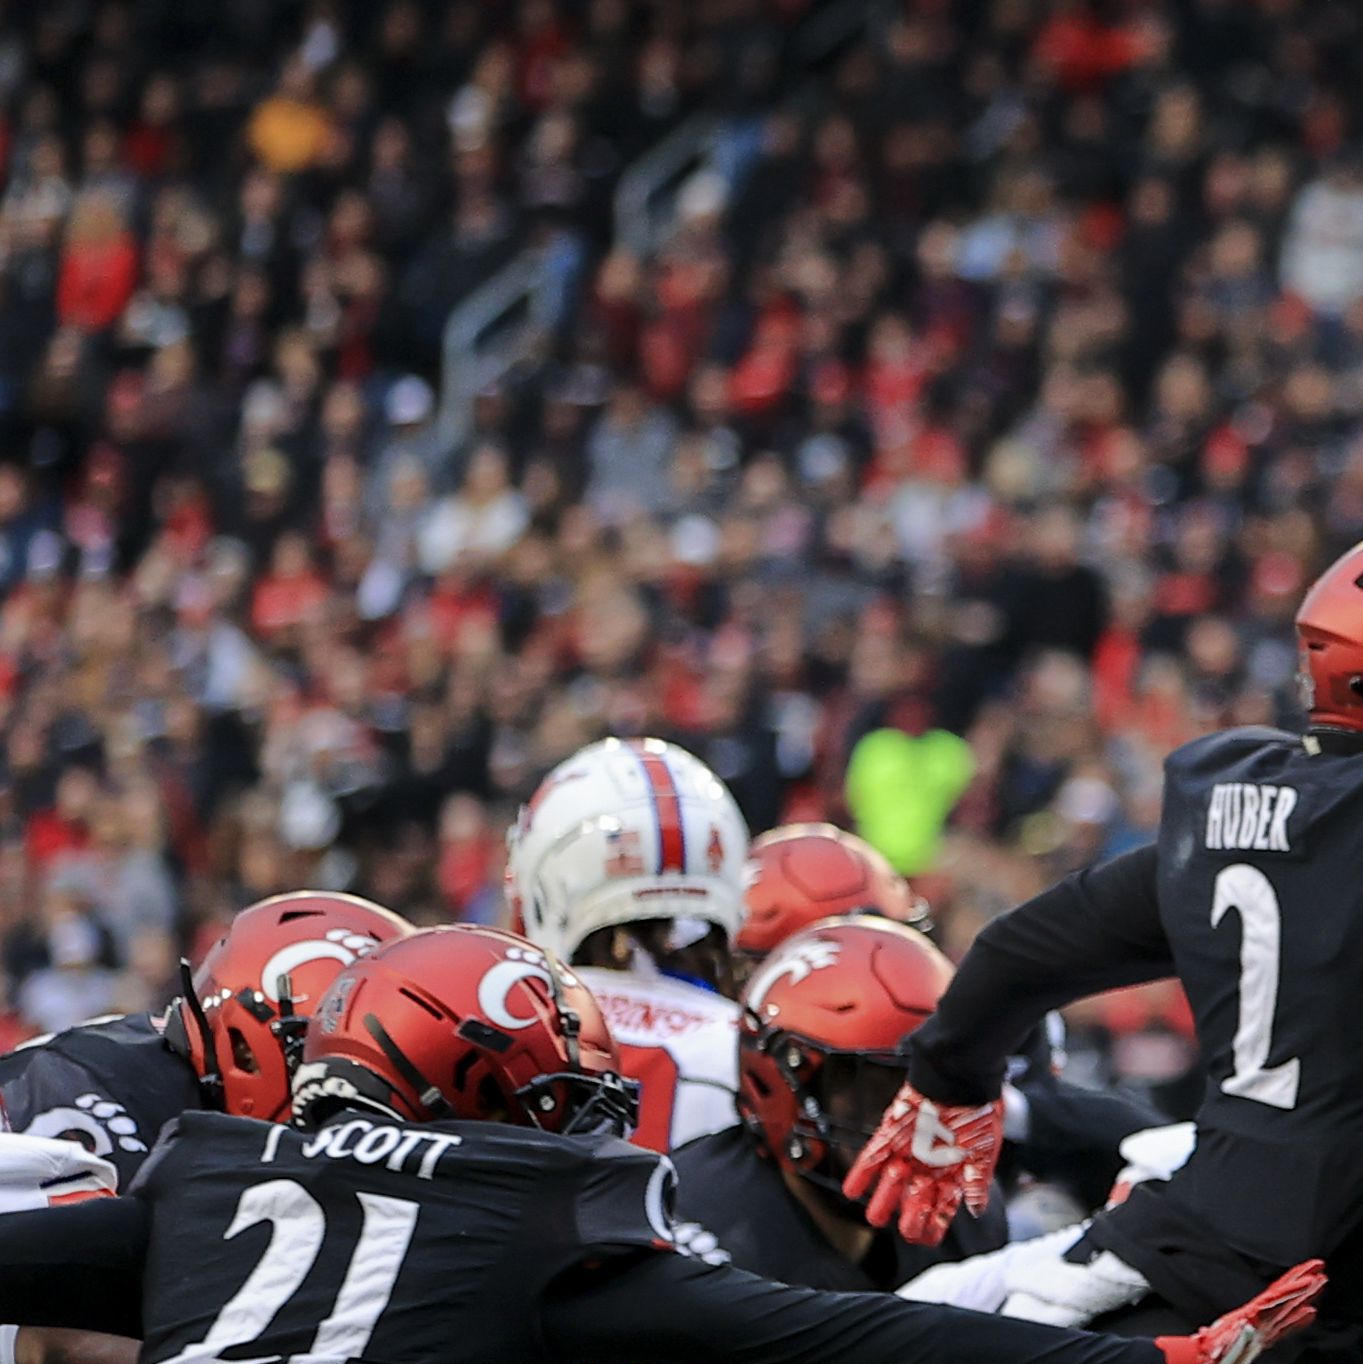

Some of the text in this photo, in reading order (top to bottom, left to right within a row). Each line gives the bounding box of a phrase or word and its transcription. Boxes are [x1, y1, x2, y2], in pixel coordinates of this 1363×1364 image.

[1206, 783, 1299, 852] HUBER
[1211, 863, 1300, 1110] 2
[302, 1119, 462, 1181] SCOTT
